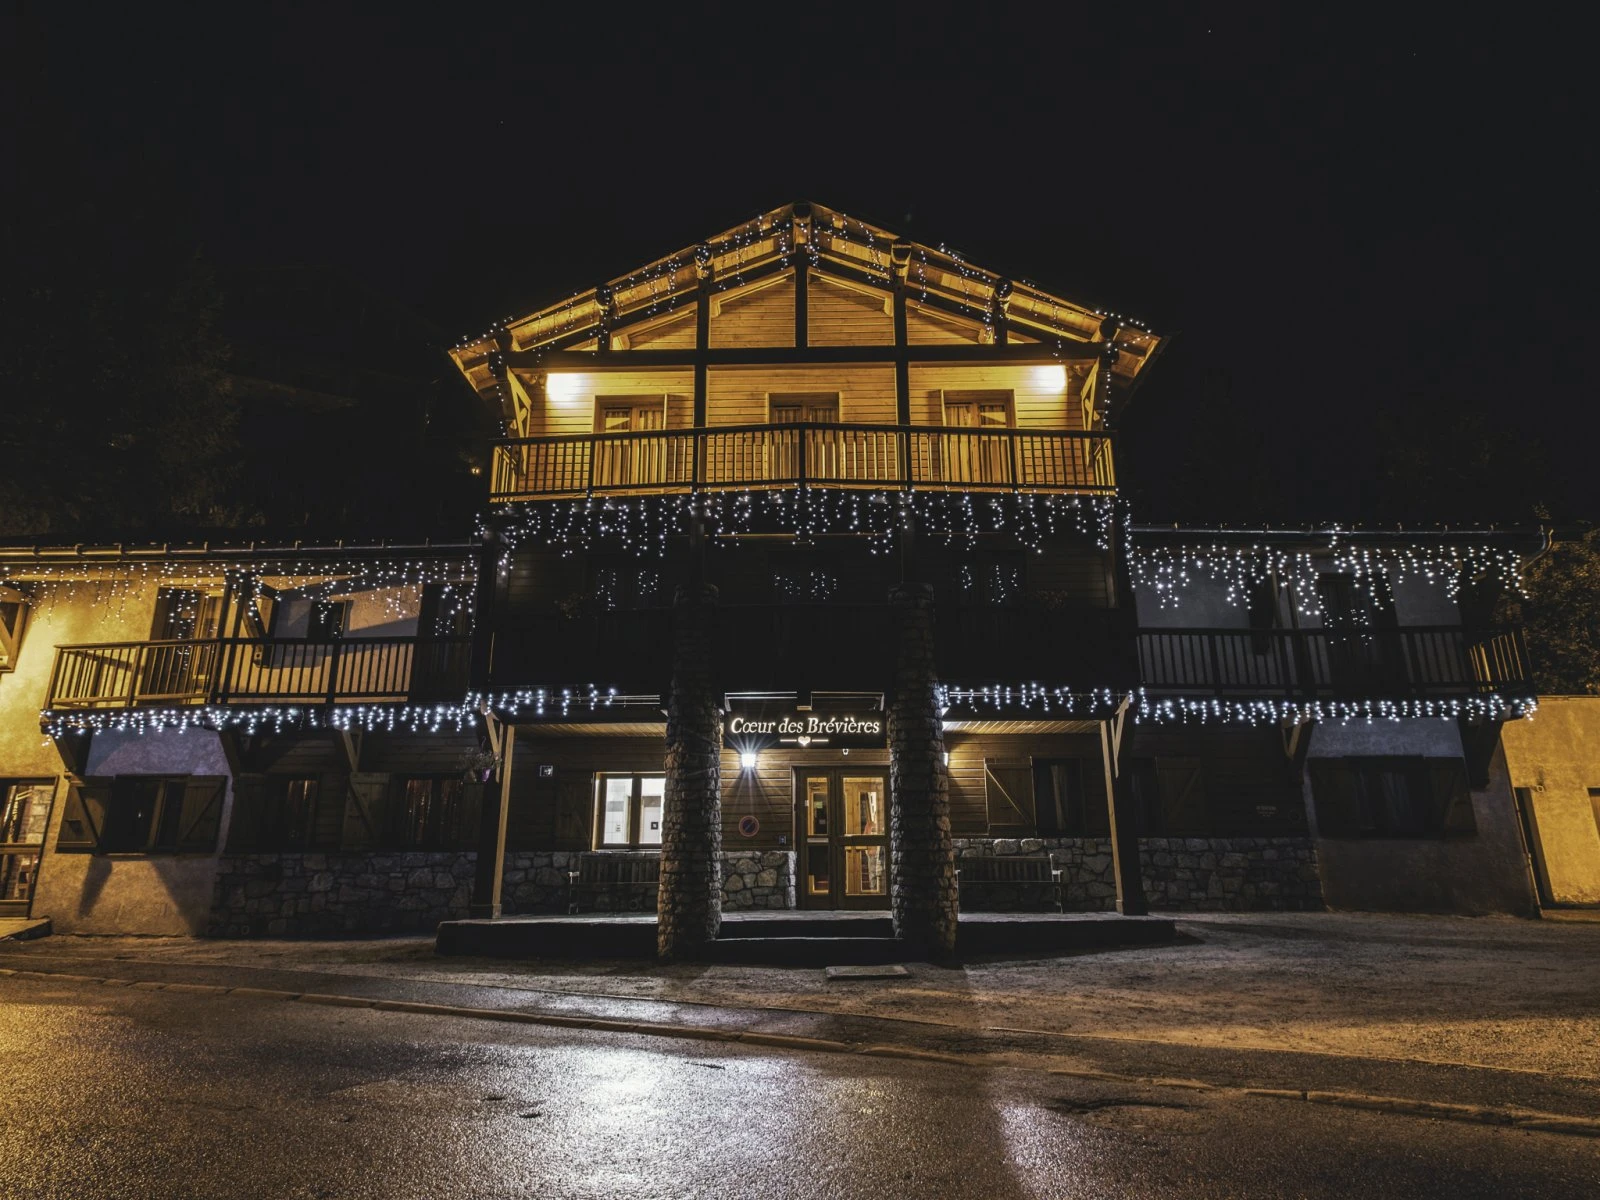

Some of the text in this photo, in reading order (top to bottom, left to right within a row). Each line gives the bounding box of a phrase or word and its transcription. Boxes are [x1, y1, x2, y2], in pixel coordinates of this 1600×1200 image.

[731, 716, 880, 734] Cœur des Brévières
